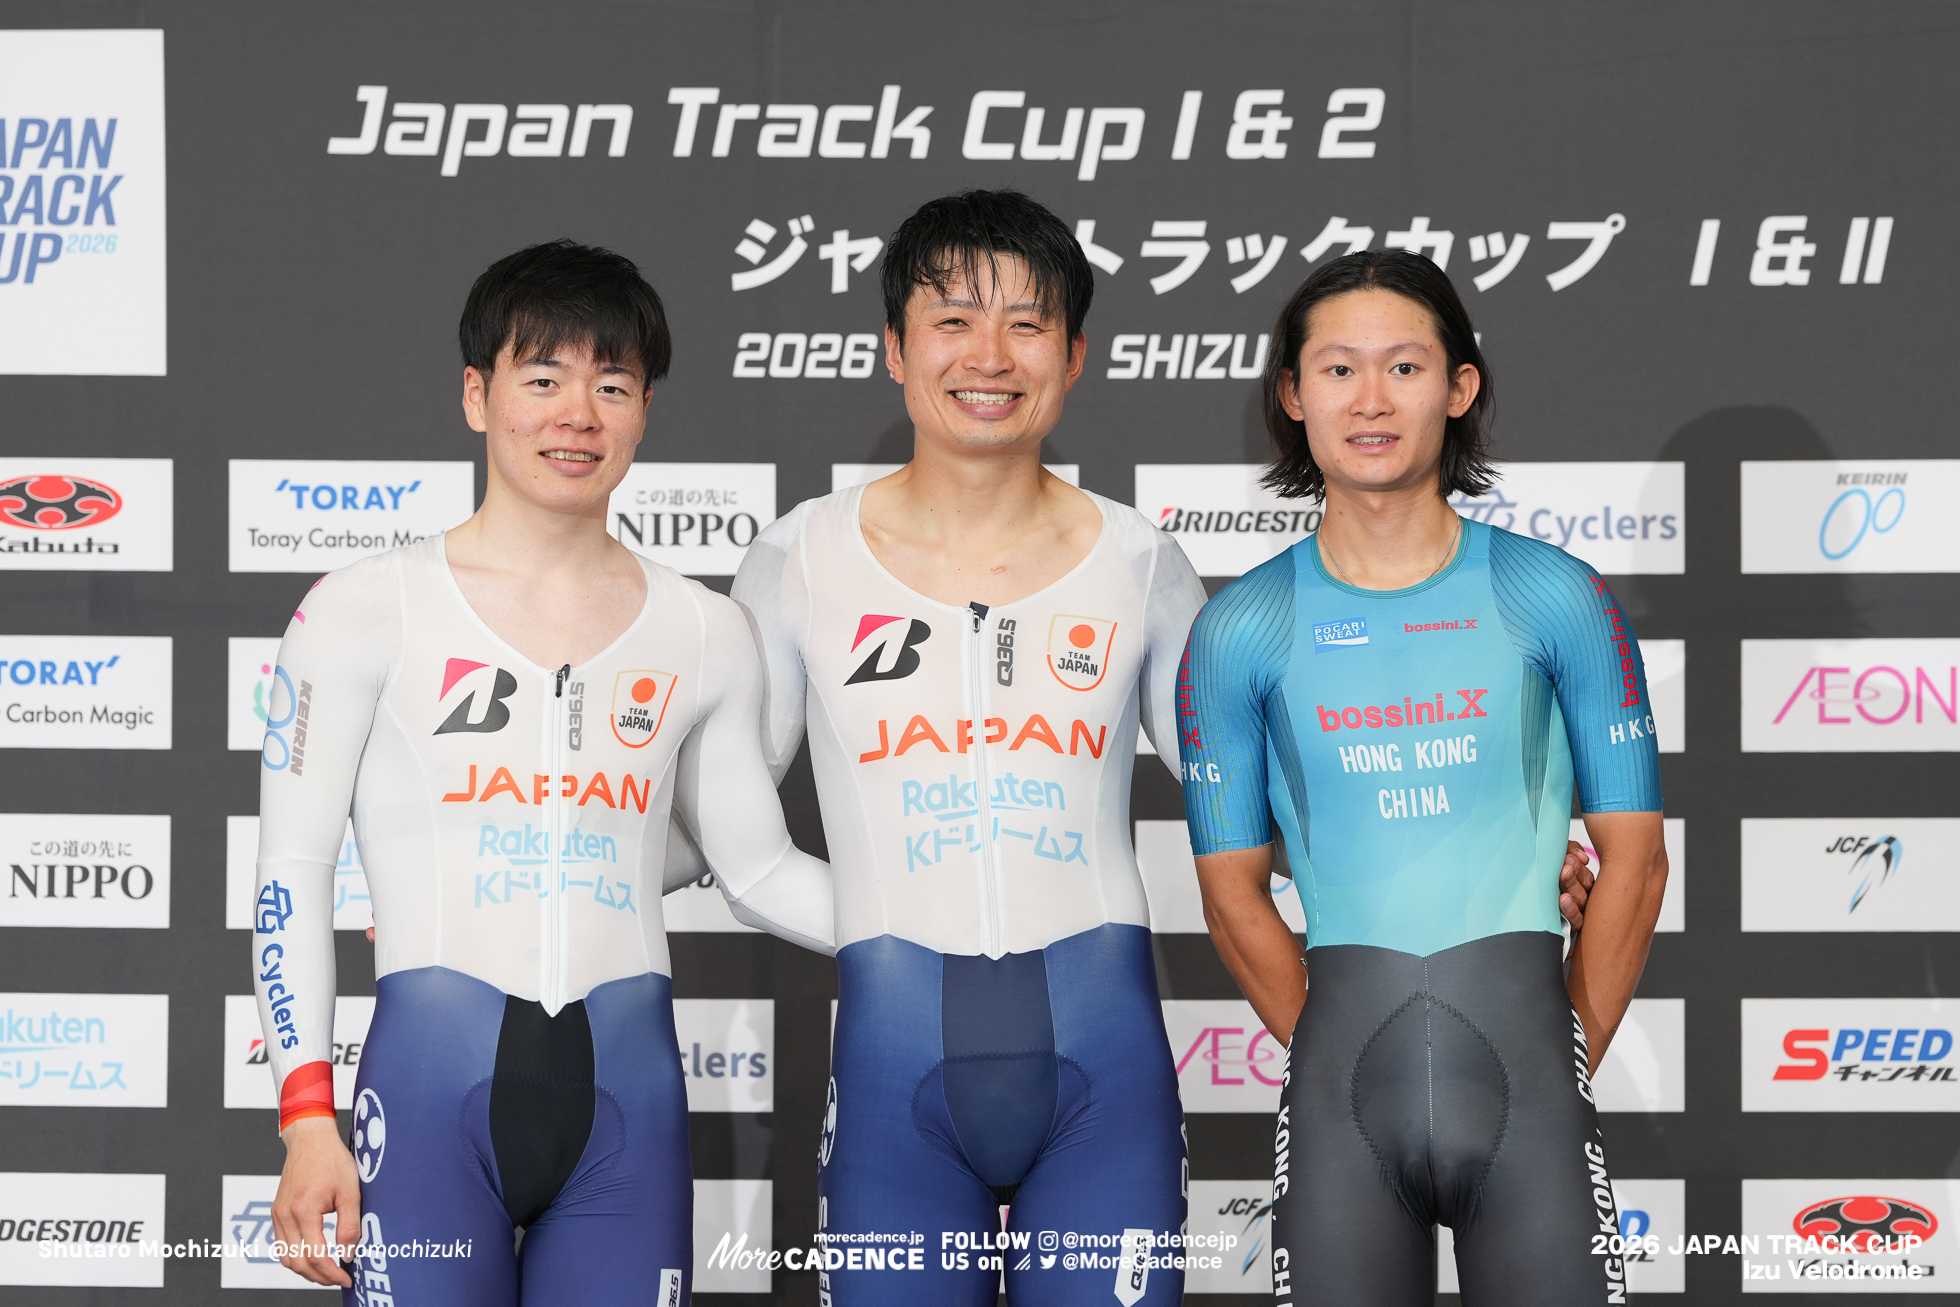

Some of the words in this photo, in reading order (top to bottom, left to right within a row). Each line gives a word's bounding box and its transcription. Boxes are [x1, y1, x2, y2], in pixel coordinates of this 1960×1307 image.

[327, 85, 633, 176] Japan
[667, 85, 934, 160] Track
[962, 90, 1146, 181] Cup
[1171, 90, 1203, 160] I
[1226, 89, 1293, 160] &
[1318, 87, 1386, 159] 2
[66, 233, 118, 254] 2026
[1749, 215, 1817, 286] &
[732, 332, 878, 379] 2026
[634, 488, 739, 507] この道の先に
[1836, 472, 1908, 487] KEIRIN
[248, 528, 302, 552] Toray
[308, 528, 385, 548] Carbon
[615, 512, 759, 548] NIPPO
[1529, 505, 1678, 548] Cyclers
[1314, 621, 1365, 636] POCARI
[1315, 628, 1361, 643] SWEAT
[1404, 619, 1478, 633] bossini.X
[1588, 574, 1640, 708] bossini.X
[996, 617, 1017, 687] Q36.5
[1057, 657, 1099, 677] JAPAN
[1067, 651, 1091, 662] TEAM
[6, 703, 84, 723] Carbon
[90, 705, 154, 730] Magic
[289, 679, 313, 777] KEIRIN
[568, 681, 585, 752] Q36.5
[618, 715, 654, 733] JAPAN
[628, 707, 649, 717] TEAM
[1316, 688, 1488, 733] bossini.X
[859, 714, 1107, 764] JAPAN
[1339, 743, 1403, 774] HONG
[1414, 734, 1477, 770] KONG
[442, 764, 651, 814] JAPAN
[902, 772, 1066, 817] Rakuten
[1378, 785, 1451, 819] CHINA
[29, 840, 133, 858] この道の先に
[477, 822, 617, 863] Rakuten
[1826, 836, 1869, 854] JCF
[9, 864, 154, 900] NIPPO
[260, 943, 299, 1050] Cyclers
[1772, 1029, 1953, 1081] SPEED
[1833, 1064, 1958, 1082] チャンネル
[1219, 1198, 1262, 1216] JCF
